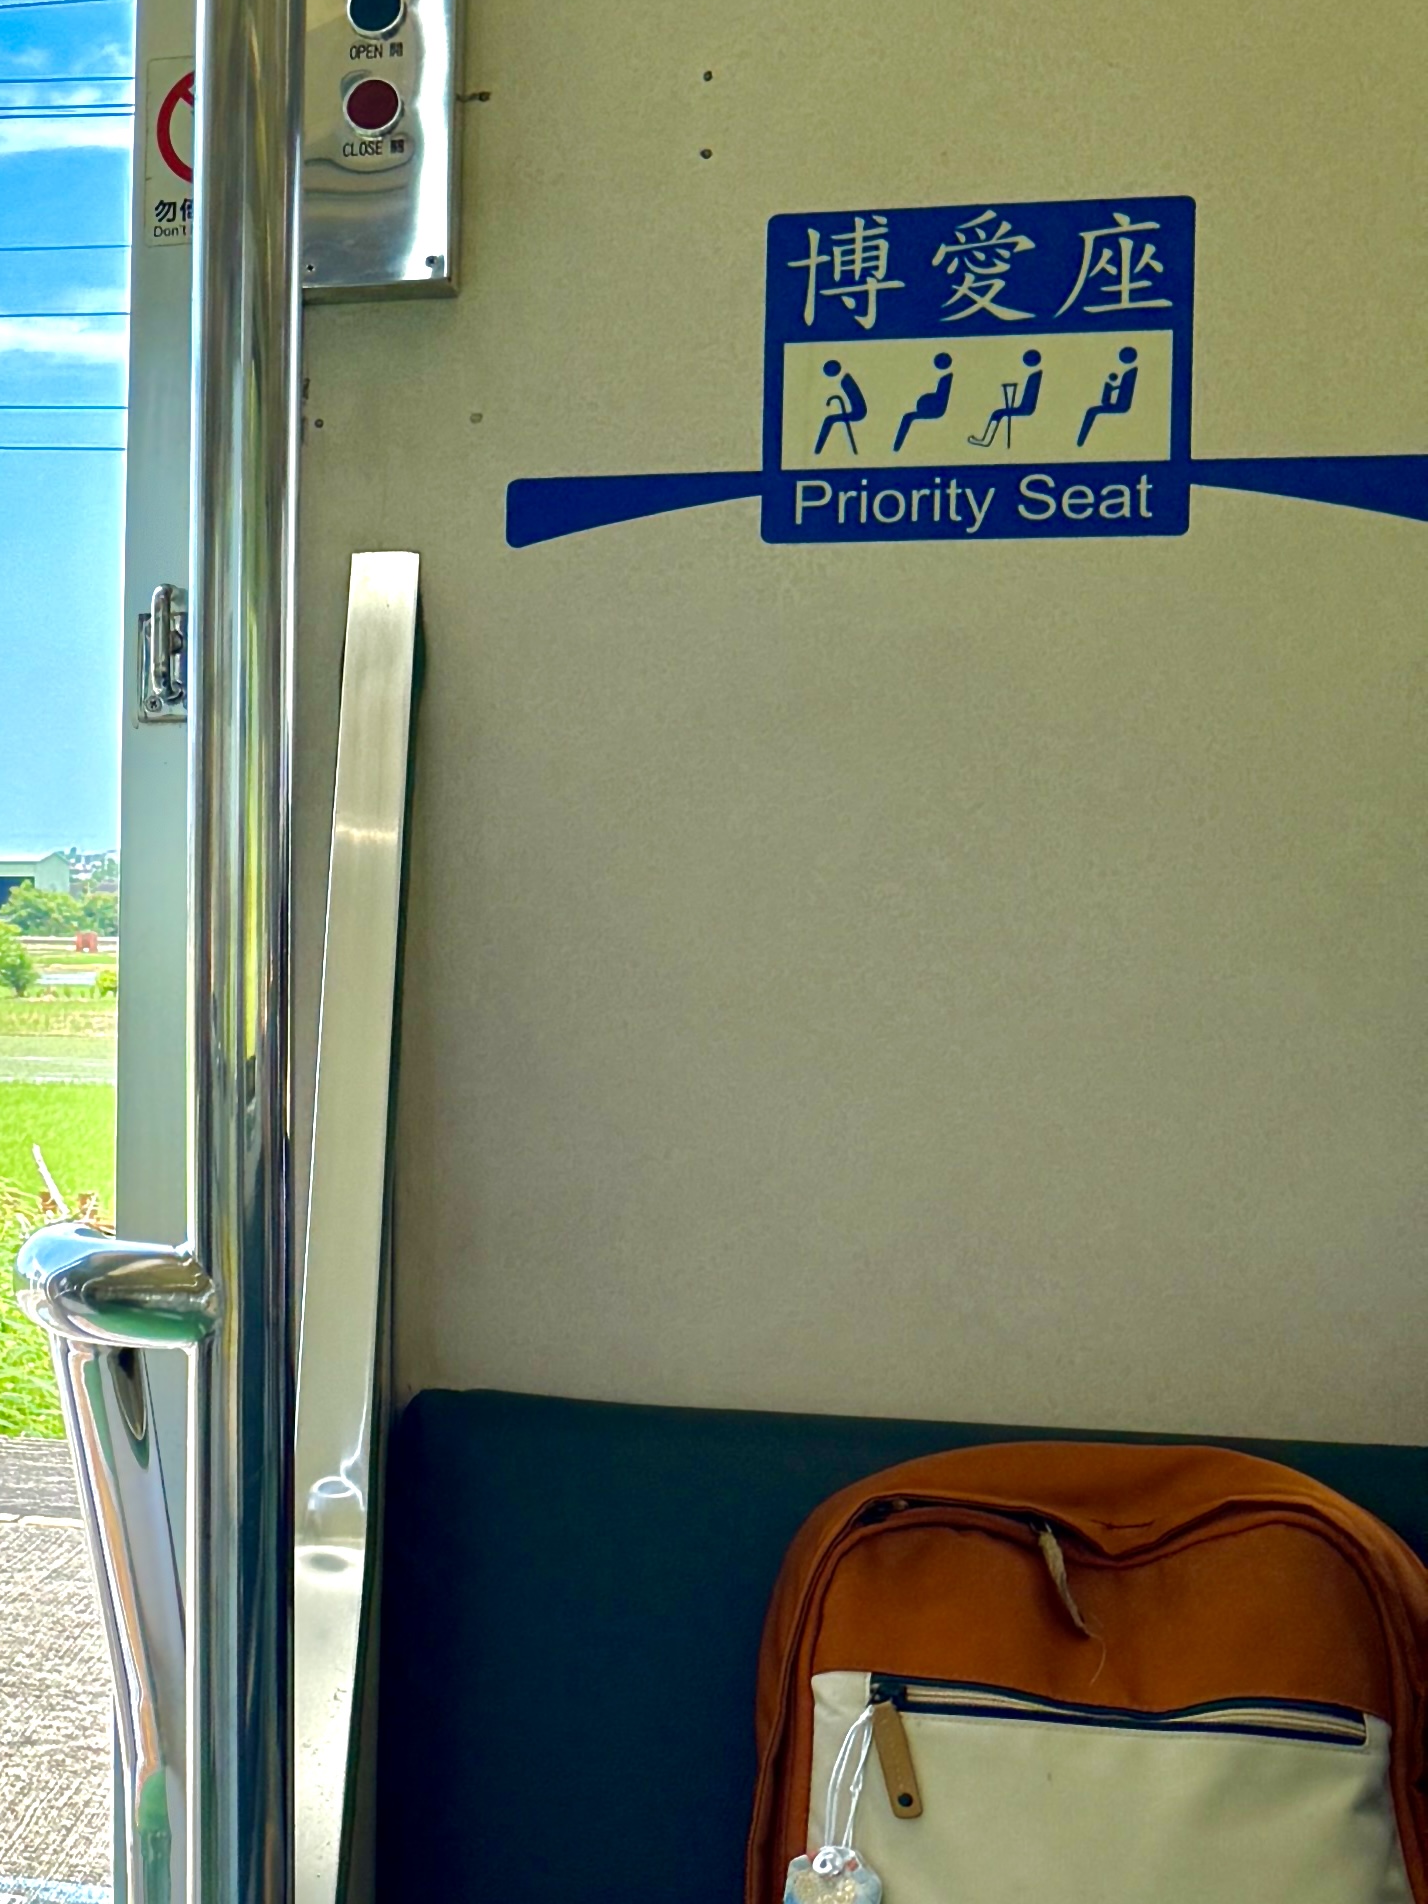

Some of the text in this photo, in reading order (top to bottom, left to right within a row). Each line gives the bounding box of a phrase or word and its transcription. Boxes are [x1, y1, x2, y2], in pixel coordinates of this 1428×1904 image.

[349, 44, 384, 60] OPEN
[342, 140, 384, 157] CLOSE
[787, 208, 1176, 331] 博愛座
[793, 472, 1153, 534] Priority Seat
